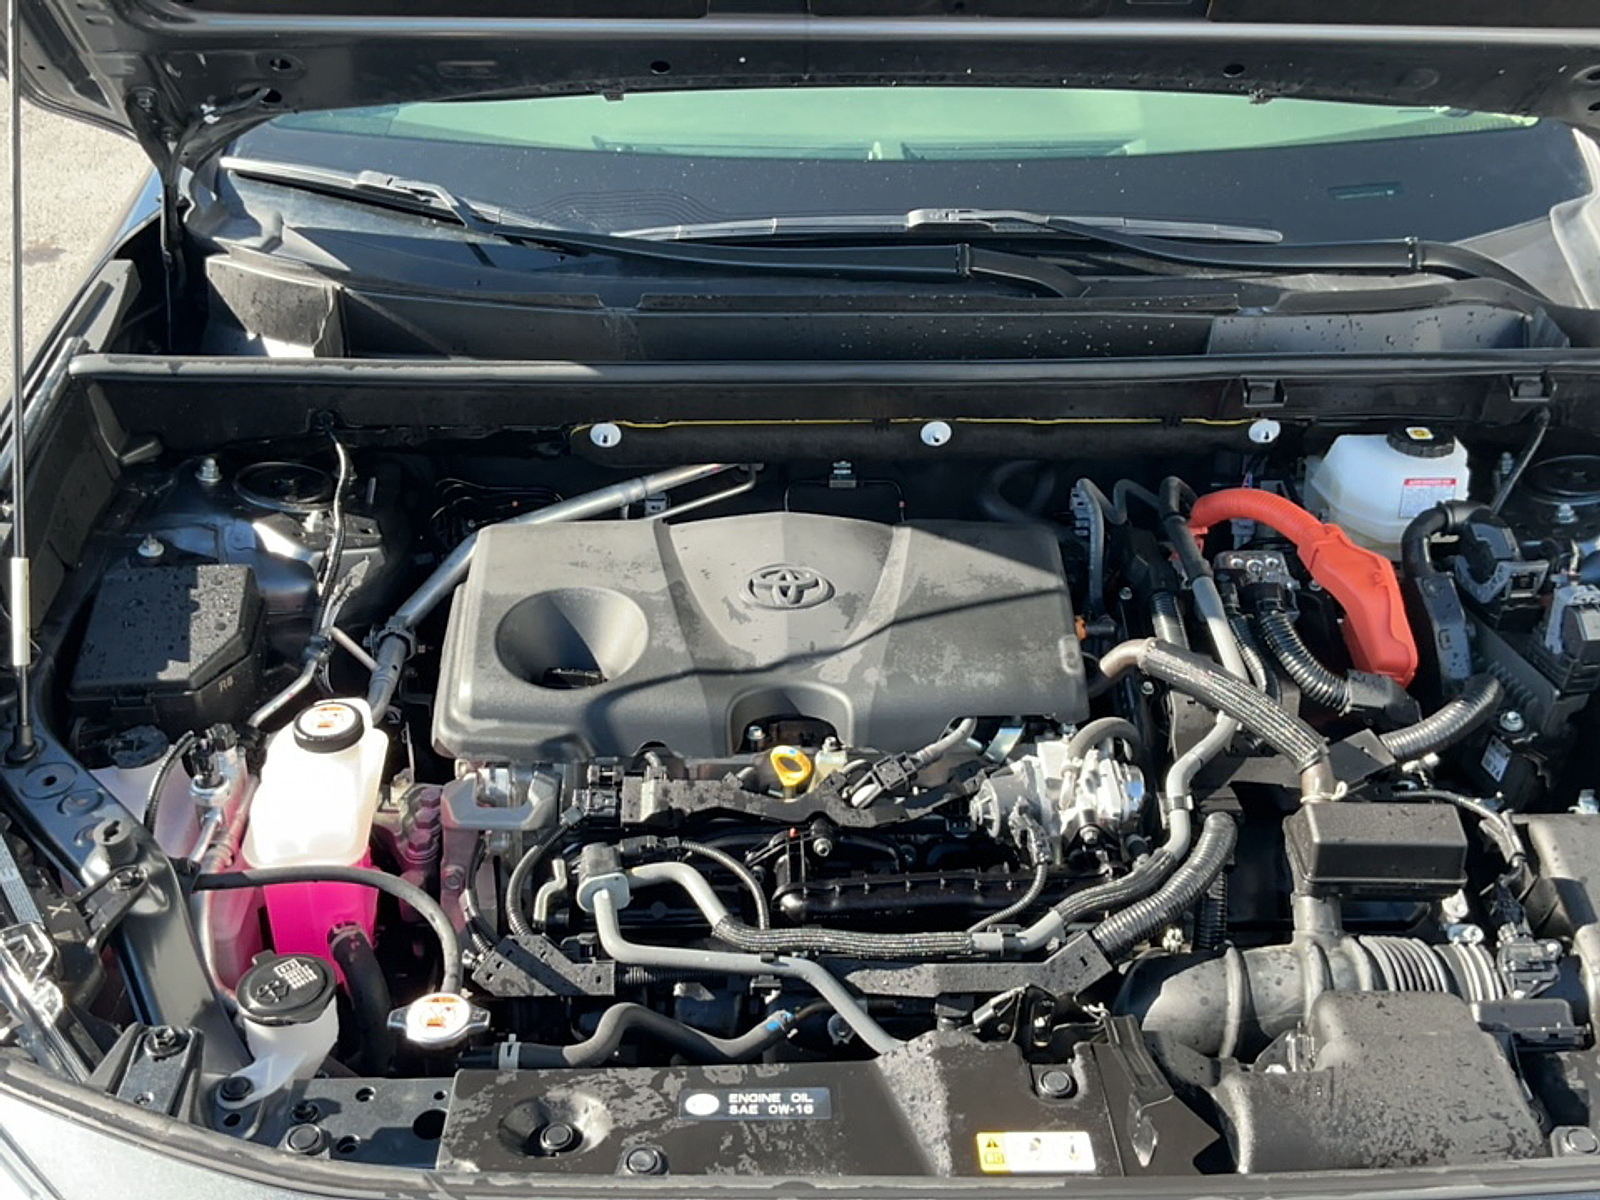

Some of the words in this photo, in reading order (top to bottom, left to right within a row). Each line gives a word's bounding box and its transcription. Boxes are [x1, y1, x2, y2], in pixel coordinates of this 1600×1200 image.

[728, 1092, 781, 1103] ENGINE
[790, 1092, 814, 1103] OIL
[728, 1104, 759, 1115] SAE
